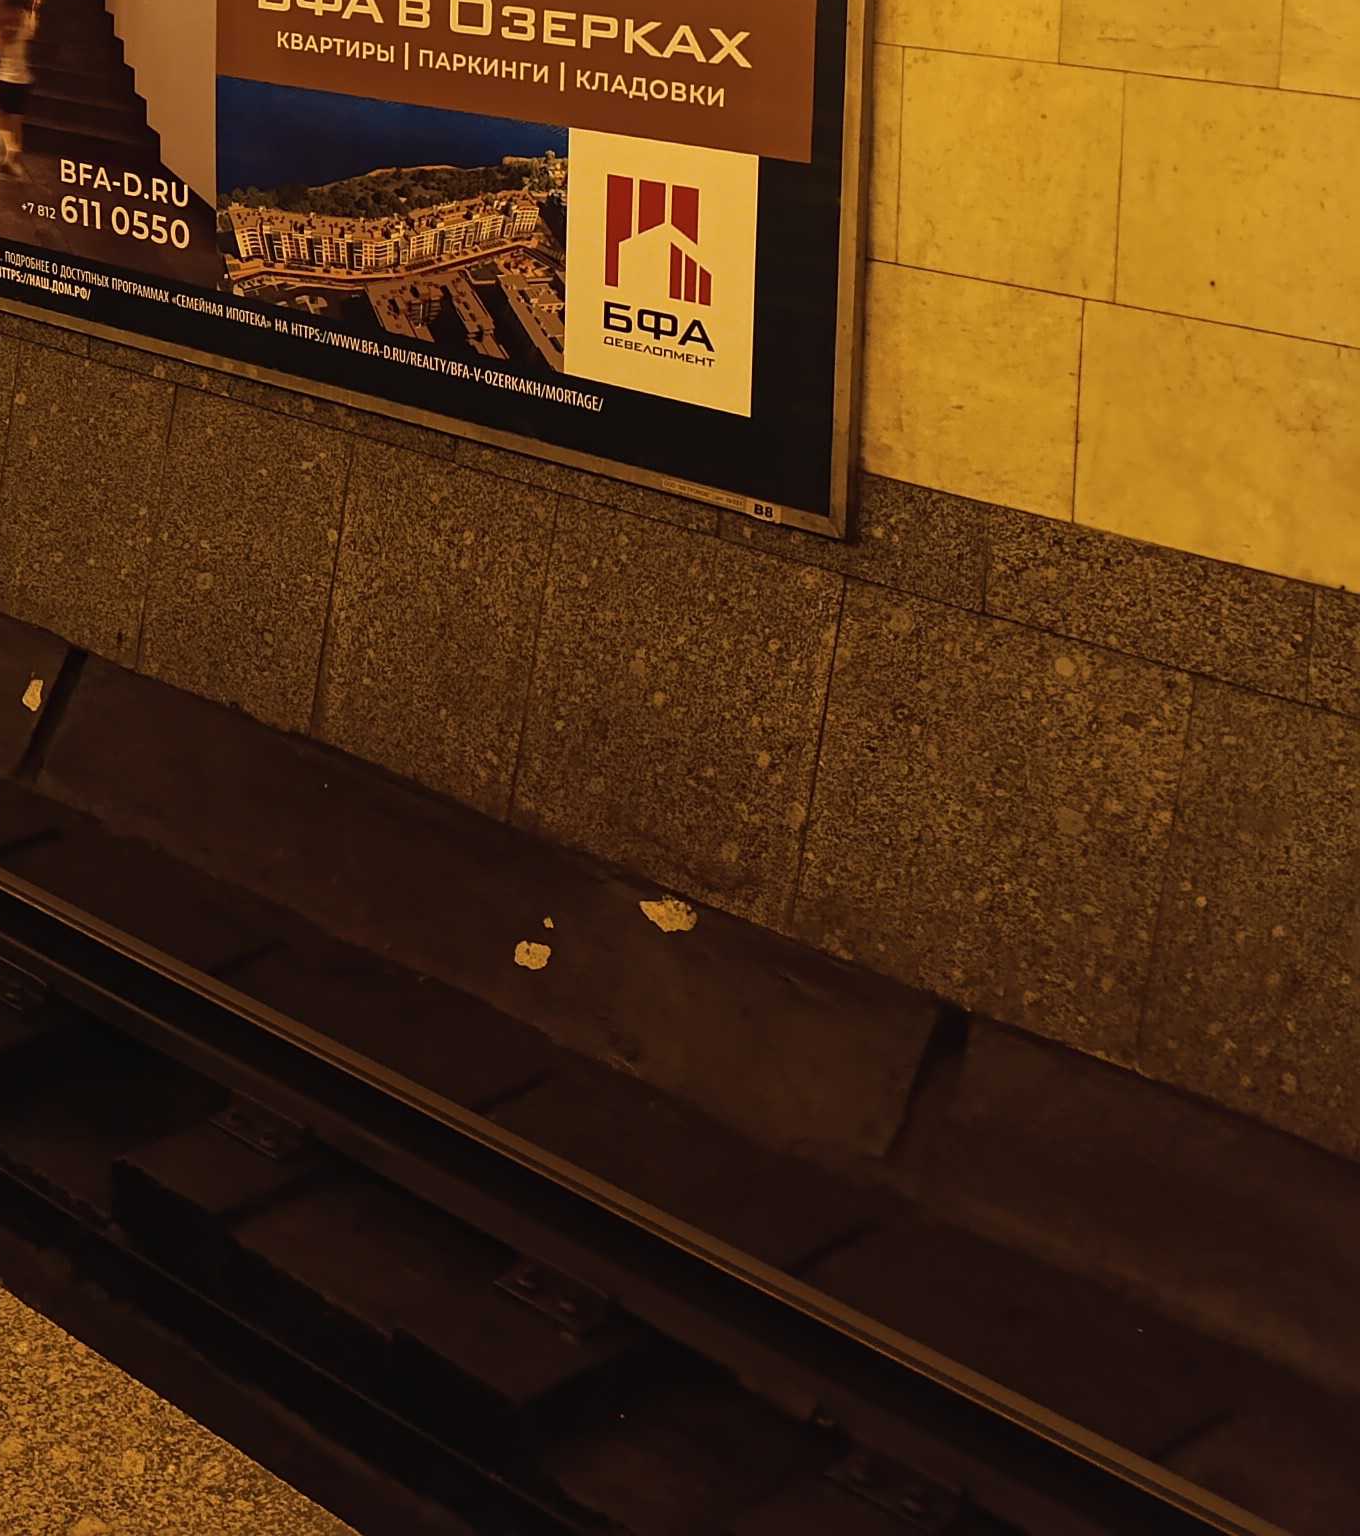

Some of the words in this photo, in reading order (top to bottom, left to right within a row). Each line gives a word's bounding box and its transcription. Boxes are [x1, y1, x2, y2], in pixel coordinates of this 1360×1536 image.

[276, 30, 395, 63] КВАРТИРЫ
[419, 49, 550, 84] ПАРКИНГИ
[576, 69, 725, 108] КЛАДОВКИ
[60, 158, 189, 207] BFA-D.RU
[21, 202, 34, 214] +7
[37, 205, 56, 219] 812
[60, 195, 101, 230] 611
[111, 206, 190, 249] 0550
[5, 250, 50, 274] ПОДРОБНЕЕ
[51, 263, 58, 275] О
[60, 264, 109, 288] ДОСТУПНЫХ
[111, 277, 169, 304] ПРОГРАММАХ
[171, 293, 223, 318] «СЕМЕЙНАЯ
[226, 307, 272, 329] ИПОТЕКА»
[274, 319, 289, 334] НА
[603, 300, 715, 353] БФА
[603, 336, 716, 368] ДЕВЕЛОПМЕНТ
